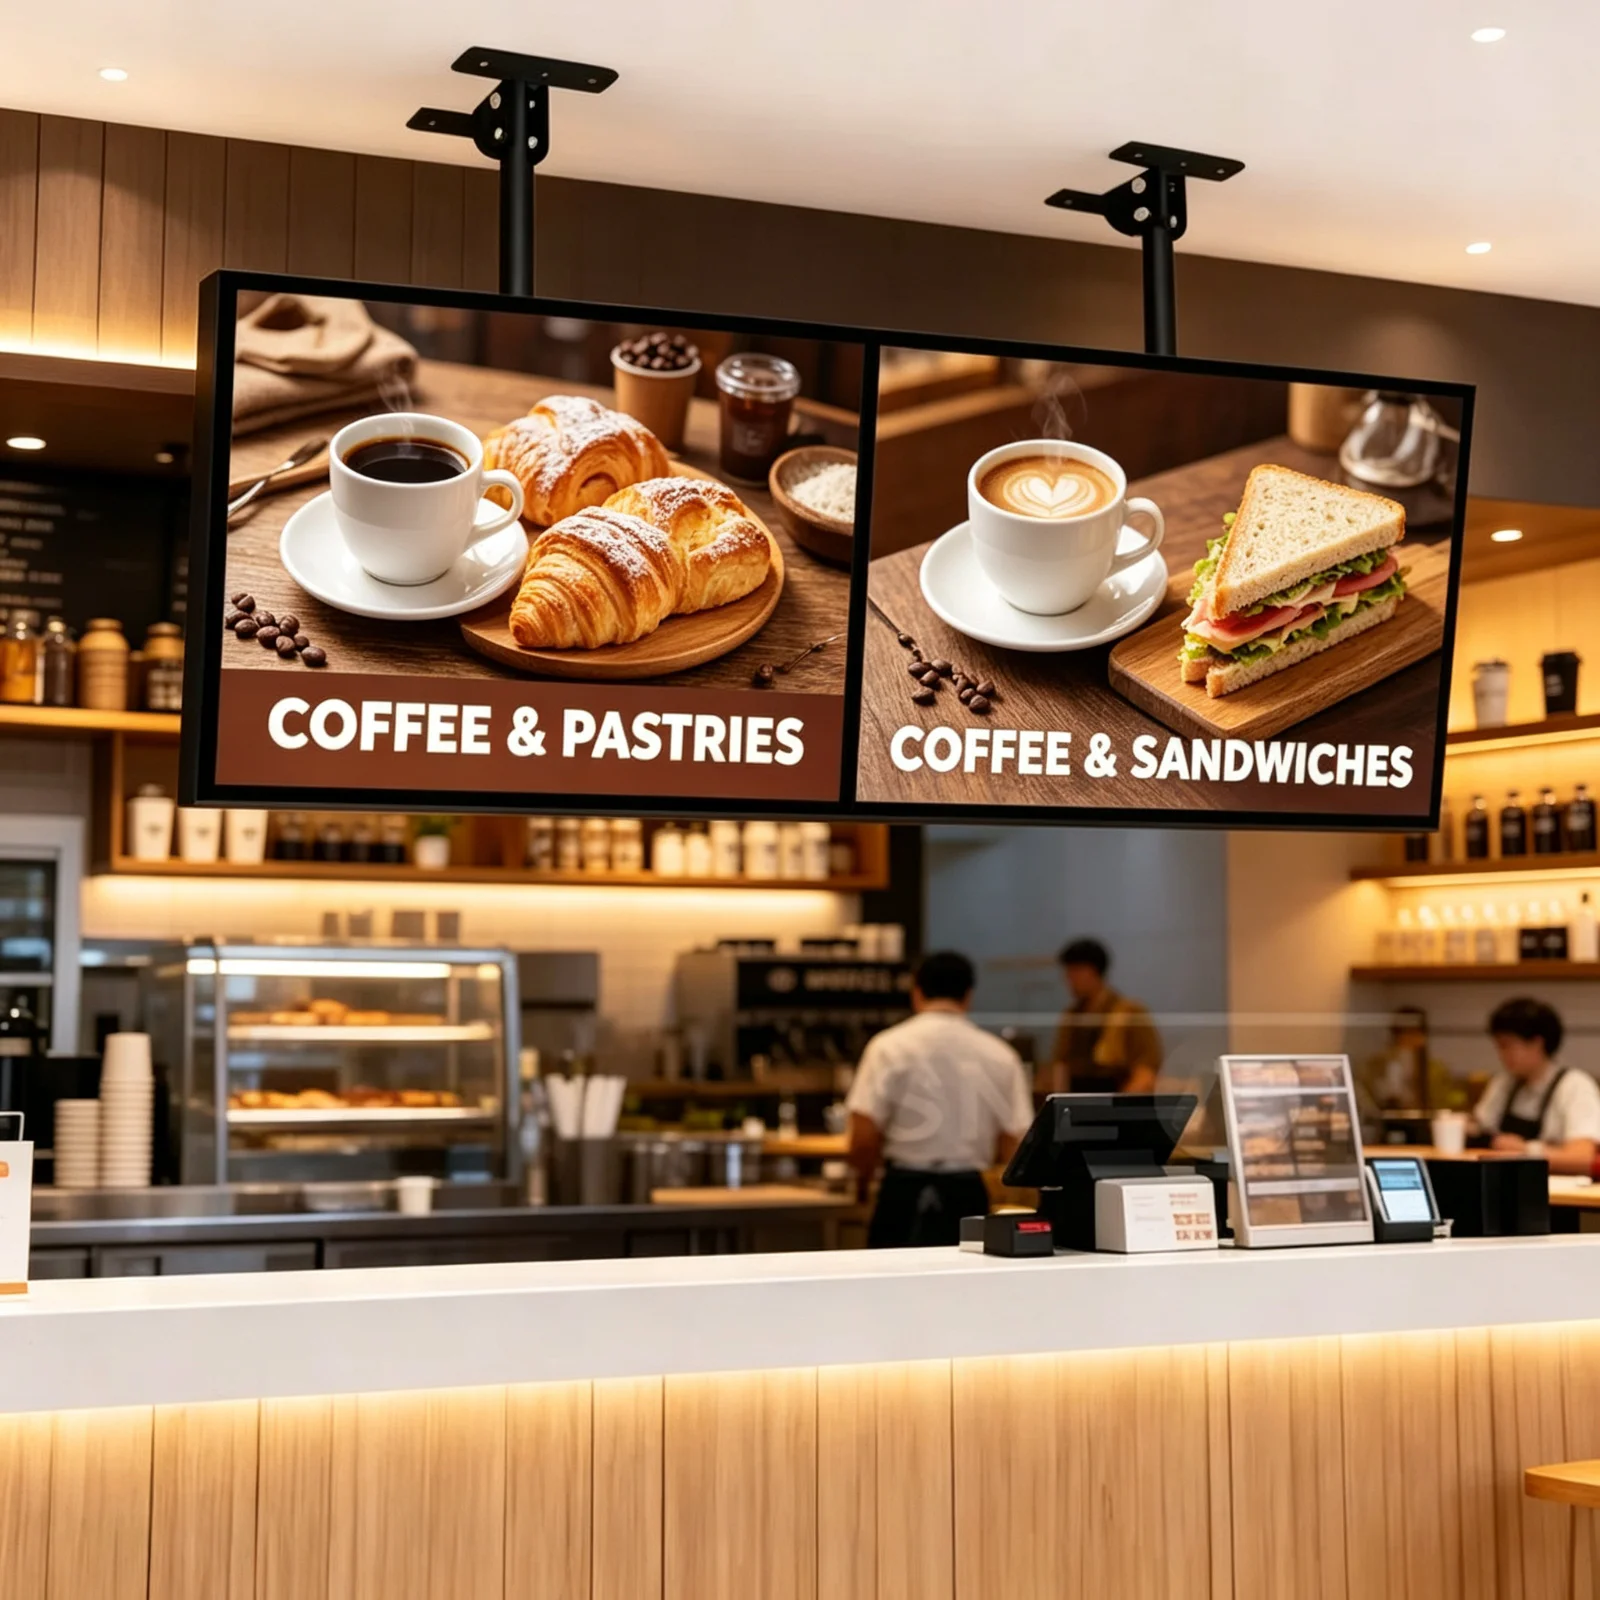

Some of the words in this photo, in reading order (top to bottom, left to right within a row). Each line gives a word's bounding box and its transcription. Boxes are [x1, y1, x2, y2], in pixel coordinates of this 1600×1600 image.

[268, 697, 492, 754] COFFEE
[507, 706, 547, 757] &
[562, 709, 804, 766] PASTRIES
[889, 724, 1072, 776] COFFEE
[1083, 732, 1118, 778] &
[1130, 734, 1413, 788] SANDWICHES
